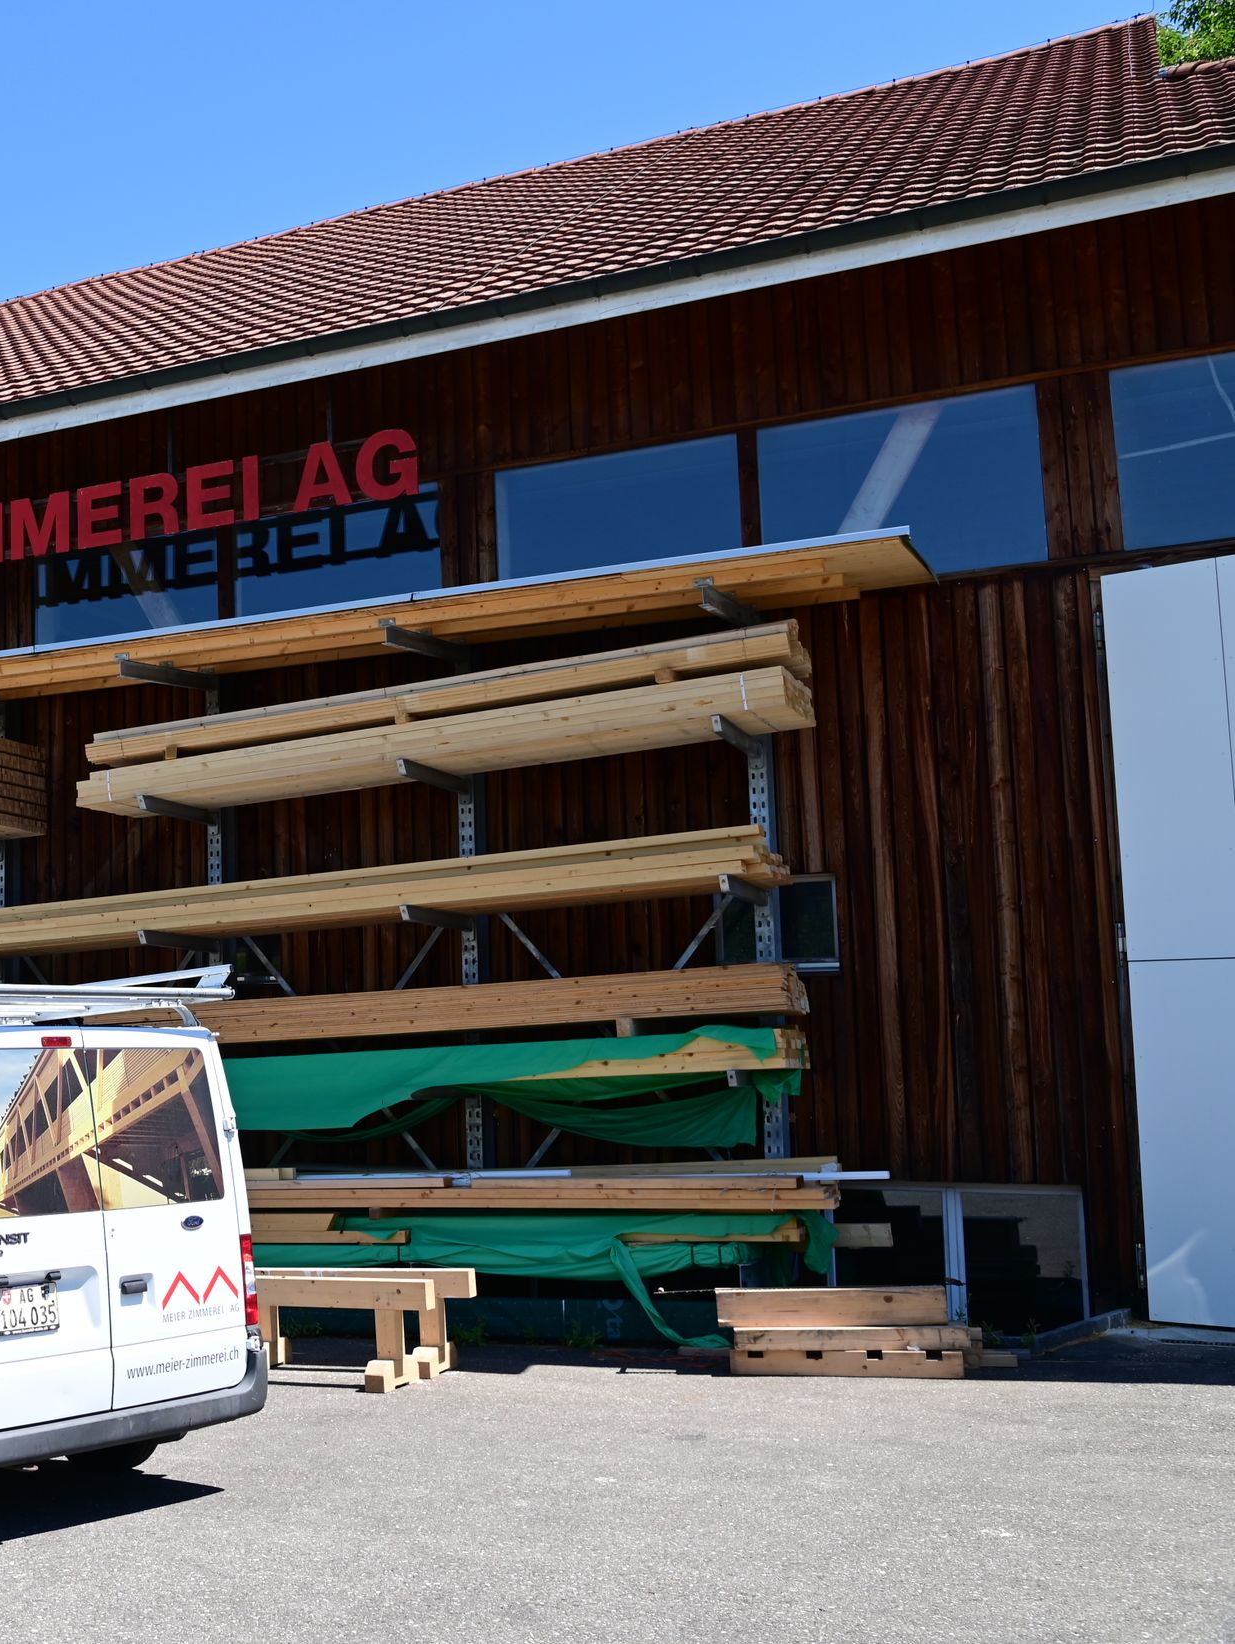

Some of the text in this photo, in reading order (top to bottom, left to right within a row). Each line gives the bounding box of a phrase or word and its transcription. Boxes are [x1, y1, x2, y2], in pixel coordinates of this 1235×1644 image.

[292, 428, 419, 513] AG
[20, 1288, 34, 1304] AG
[162, 1302, 240, 1323] MEIER ZIMMEREI AG
[126, 1345, 239, 1380] www.meier-zimmerei.ch
